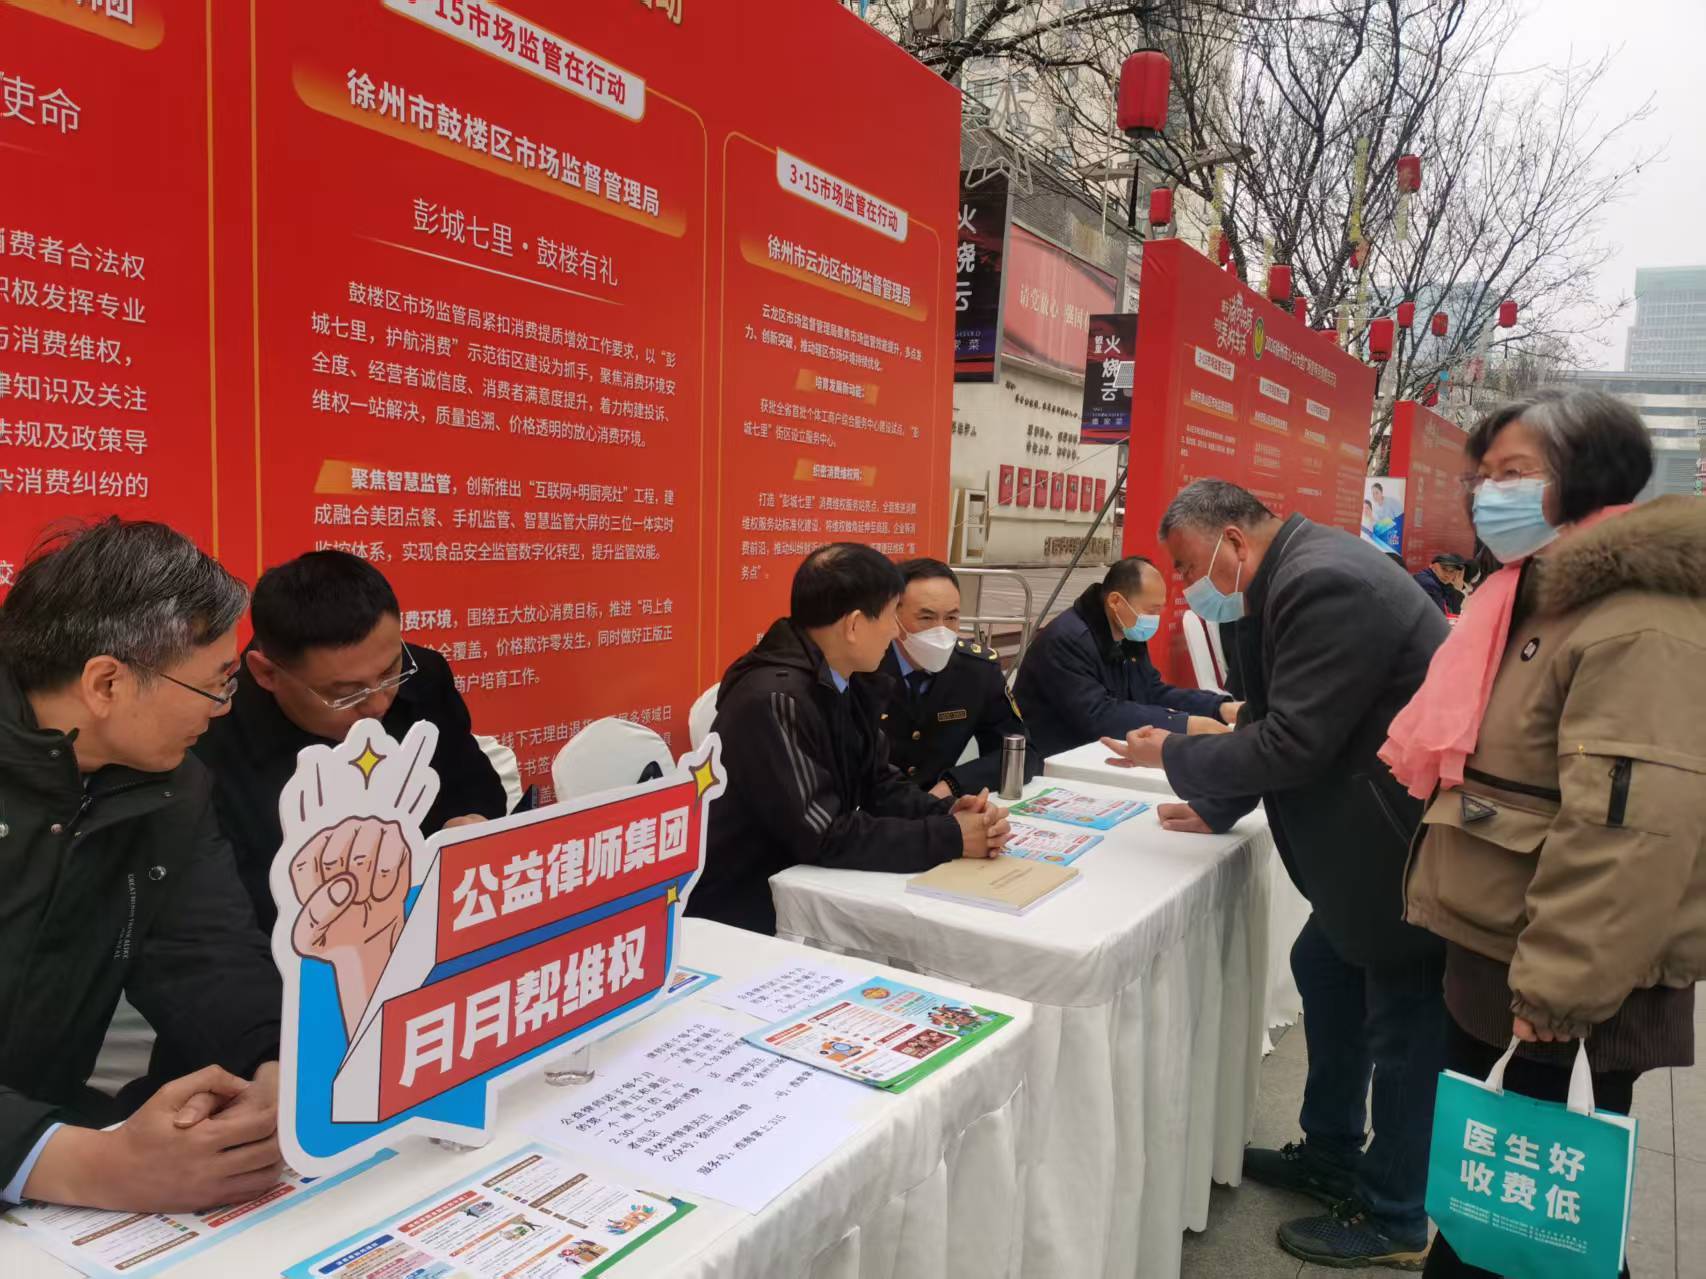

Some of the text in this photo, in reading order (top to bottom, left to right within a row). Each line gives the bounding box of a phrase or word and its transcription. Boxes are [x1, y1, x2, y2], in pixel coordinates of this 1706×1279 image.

[407, 0, 626, 105] 15市场监管在行动
[0, 72, 81, 133] 使命
[347, 68, 660, 217] 徐州市鼓楼区市场监督管理局
[790, 164, 899, 233] 3·15市场监管在行动
[0, 228, 145, 280] 费者合法权
[413, 198, 618, 286] 彭城七里·鼓楼有礼
[768, 234, 911, 307] 徐州市云龙区市场监督管理局
[0, 276, 147, 324] 极发挥专业
[0, 325, 134, 367] 消费维权，
[1101, 335, 1121, 401] 火烧云
[424, 626, 673, 662] 全覆盖，价格欺诈零发生，同时做好正版正
[452, 805, 690, 932] 公益律师集团
[398, 926, 647, 1087] 月月帮维权
[1463, 1118, 1586, 1183] 医生好
[1460, 1160, 1581, 1225] 收费低
